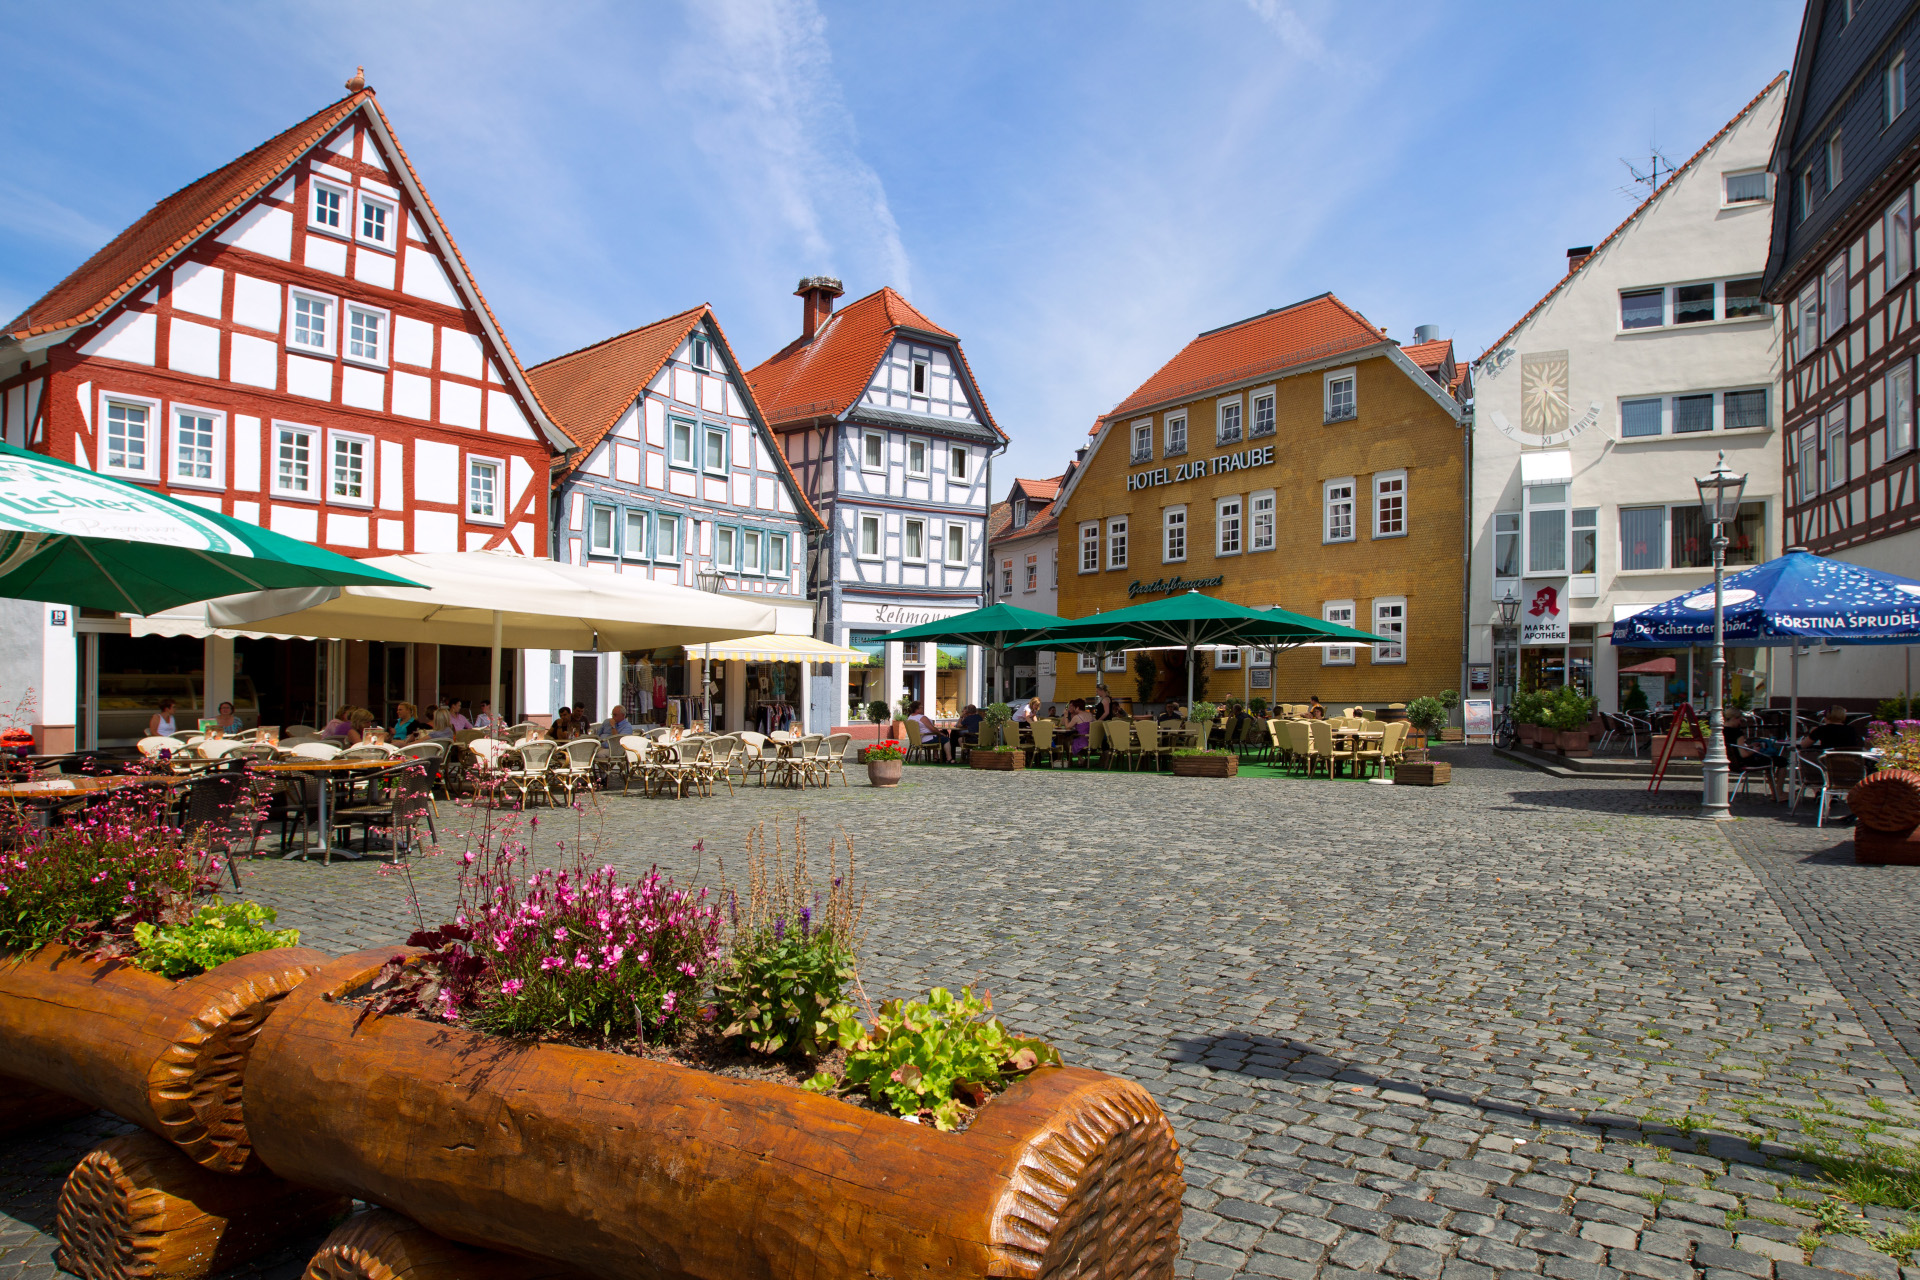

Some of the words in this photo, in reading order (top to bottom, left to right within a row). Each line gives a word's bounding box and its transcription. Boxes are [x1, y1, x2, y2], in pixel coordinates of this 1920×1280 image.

[1127, 468, 1172, 491] HOTEL
[1175, 460, 1207, 482] ZUR
[1210, 445, 1275, 475] TRAUBE
[0, 489, 147, 514] Licher
[1128, 574, 1224, 599] Gasthofbrauerei
[53, 611, 65, 620] 19
[1774, 615, 1846, 628] FÖRSTINA
[1848, 614, 1920, 628] SPRUDEL
[1635, 624, 1656, 635] Der
[1658, 624, 1693, 635] Schatz
[1696, 623, 1715, 634] der
[1721, 620, 1750, 632] hön.
